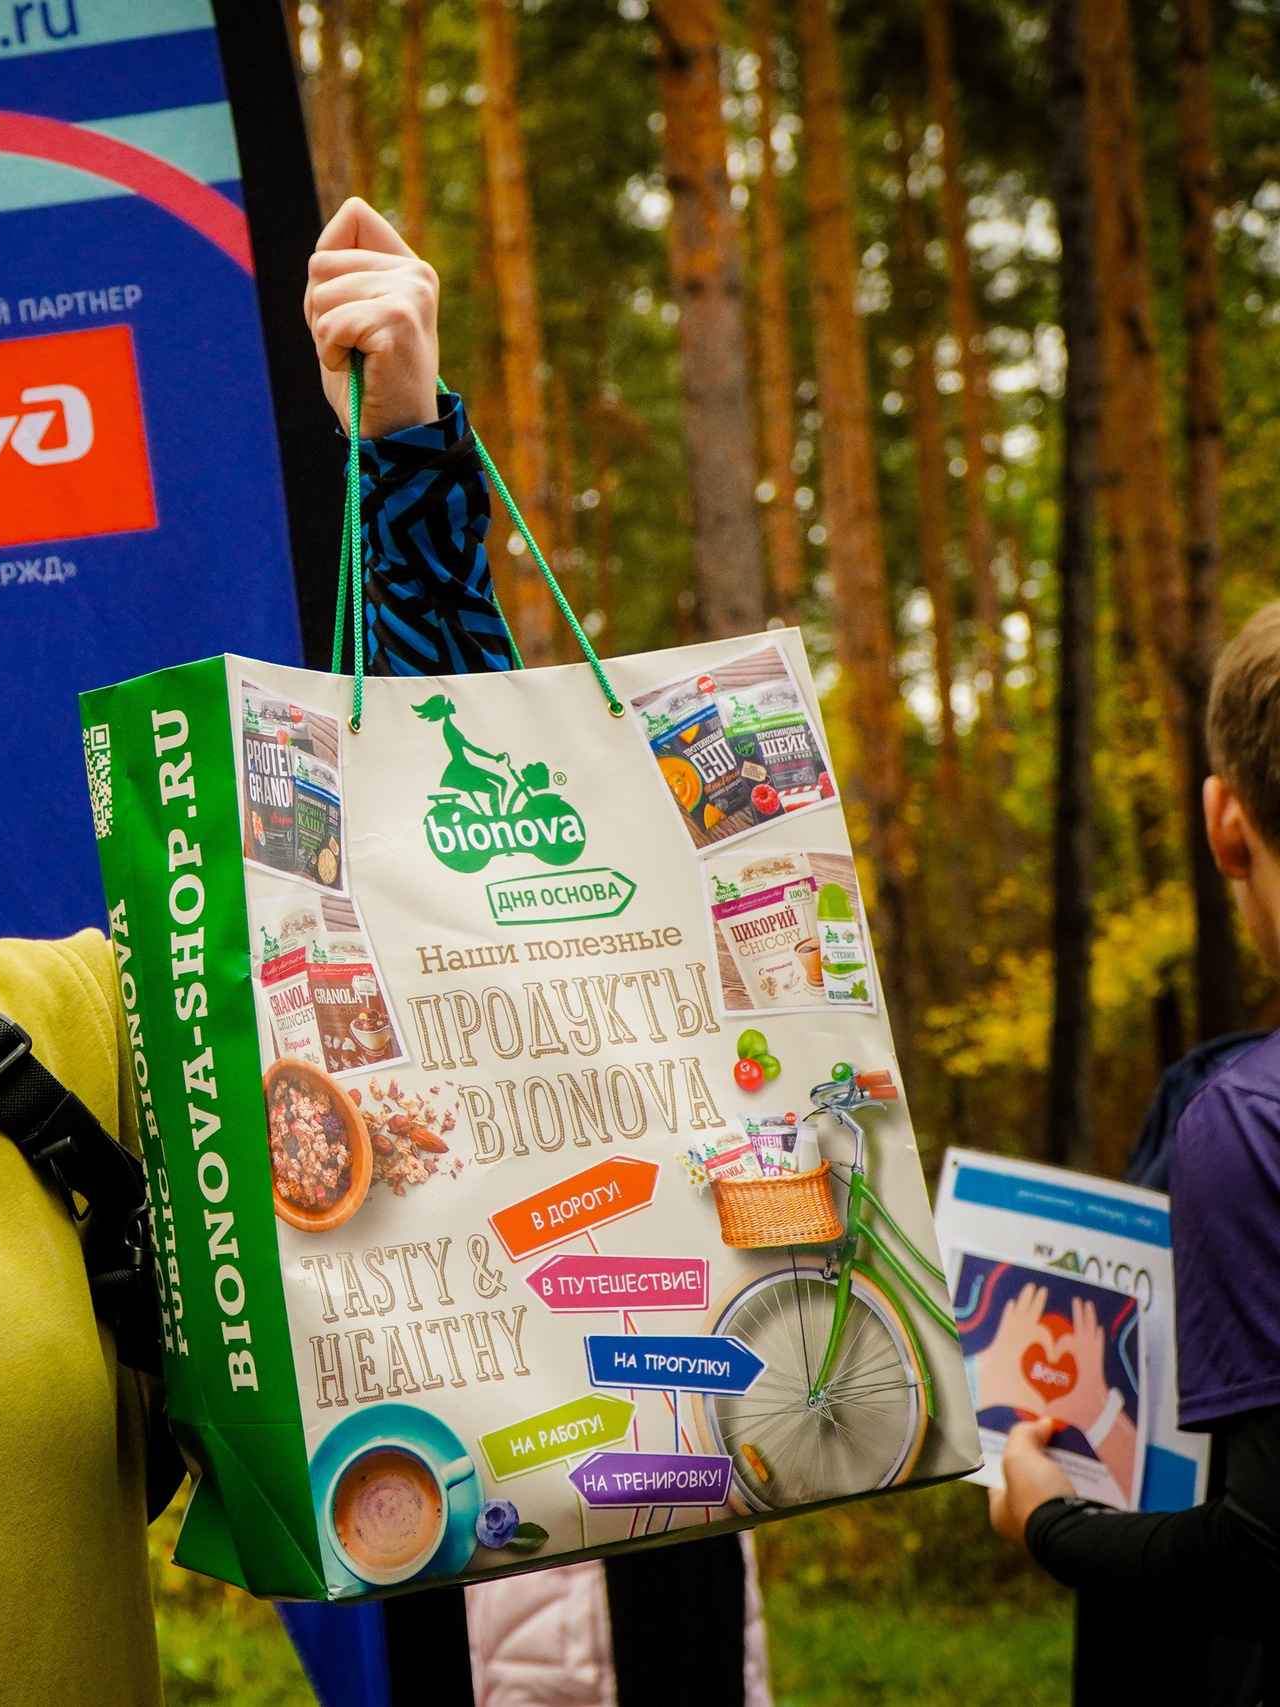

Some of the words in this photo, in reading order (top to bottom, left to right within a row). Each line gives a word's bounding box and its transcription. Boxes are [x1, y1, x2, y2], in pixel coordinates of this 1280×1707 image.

[18, 284, 143, 323] ПАРТНЕР
[689, 737, 737, 784] СУП
[759, 733, 811, 758] ШЕЙК
[298, 812, 326, 836] КАША
[426, 812, 584, 853] bionova
[498, 890, 536, 913] ДНЯ
[540, 881, 622, 908] ОСНОВА
[730, 905, 799, 944] ЦИКОРИЙ
[738, 928, 802, 957] CHICORY
[416, 943, 519, 974] Наши
[524, 926, 683, 962] полезные
[314, 988, 363, 1005] GRANOLA
[276, 1006, 316, 1031] CRUNCHY
[408, 962, 721, 1071] ПРОДУКТЫ
[151, 709, 259, 1392] BIONOVA-SHOP.RU
[458, 1057, 726, 1165] BIONOVA
[530, 1212, 545, 1231] В
[549, 1180, 623, 1228] ДОРОГУ!
[300, 1236, 455, 1323] TASTY
[467, 1234, 507, 1299] &
[542, 1277, 554, 1297] В
[558, 1270, 702, 1296] ПУТЕШЕСТВИЕ!
[309, 1305, 530, 1409] HEALTHY
[613, 1351, 638, 1370] НА
[644, 1354, 731, 1378] ПРОГУЛКУ!
[509, 1437, 534, 1458] НА
[538, 1414, 605, 1450] РАБОТУ!
[582, 1473, 608, 1493] НА
[612, 1469, 722, 1493] ТРЕНИРОВКУ!
